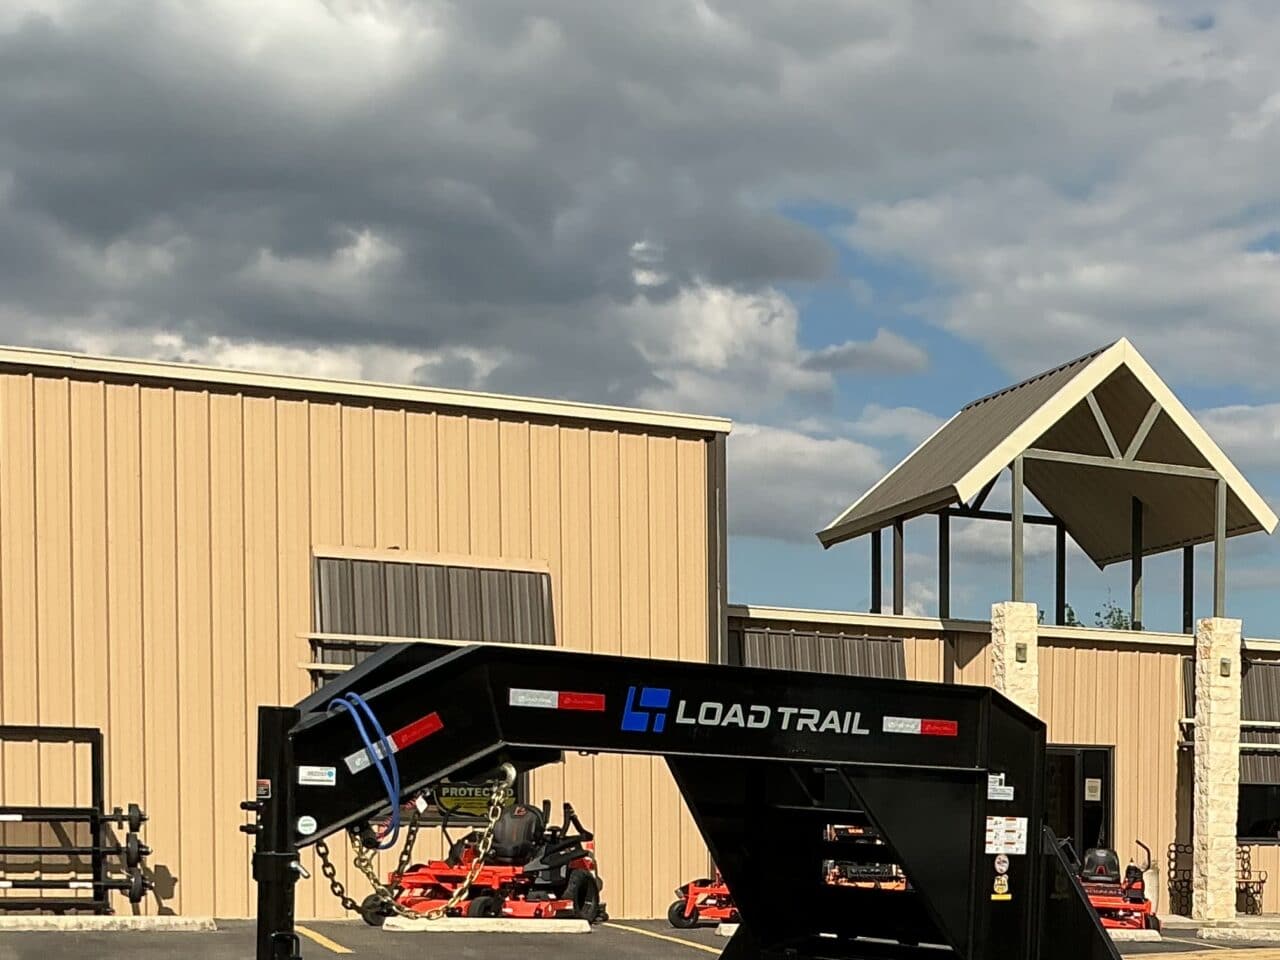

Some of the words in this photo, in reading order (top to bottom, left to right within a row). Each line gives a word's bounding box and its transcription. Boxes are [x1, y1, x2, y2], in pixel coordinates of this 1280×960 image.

[675, 699, 772, 729] LOAD
[776, 706, 871, 735] TRAIL
[441, 787, 514, 797] PROTECD
